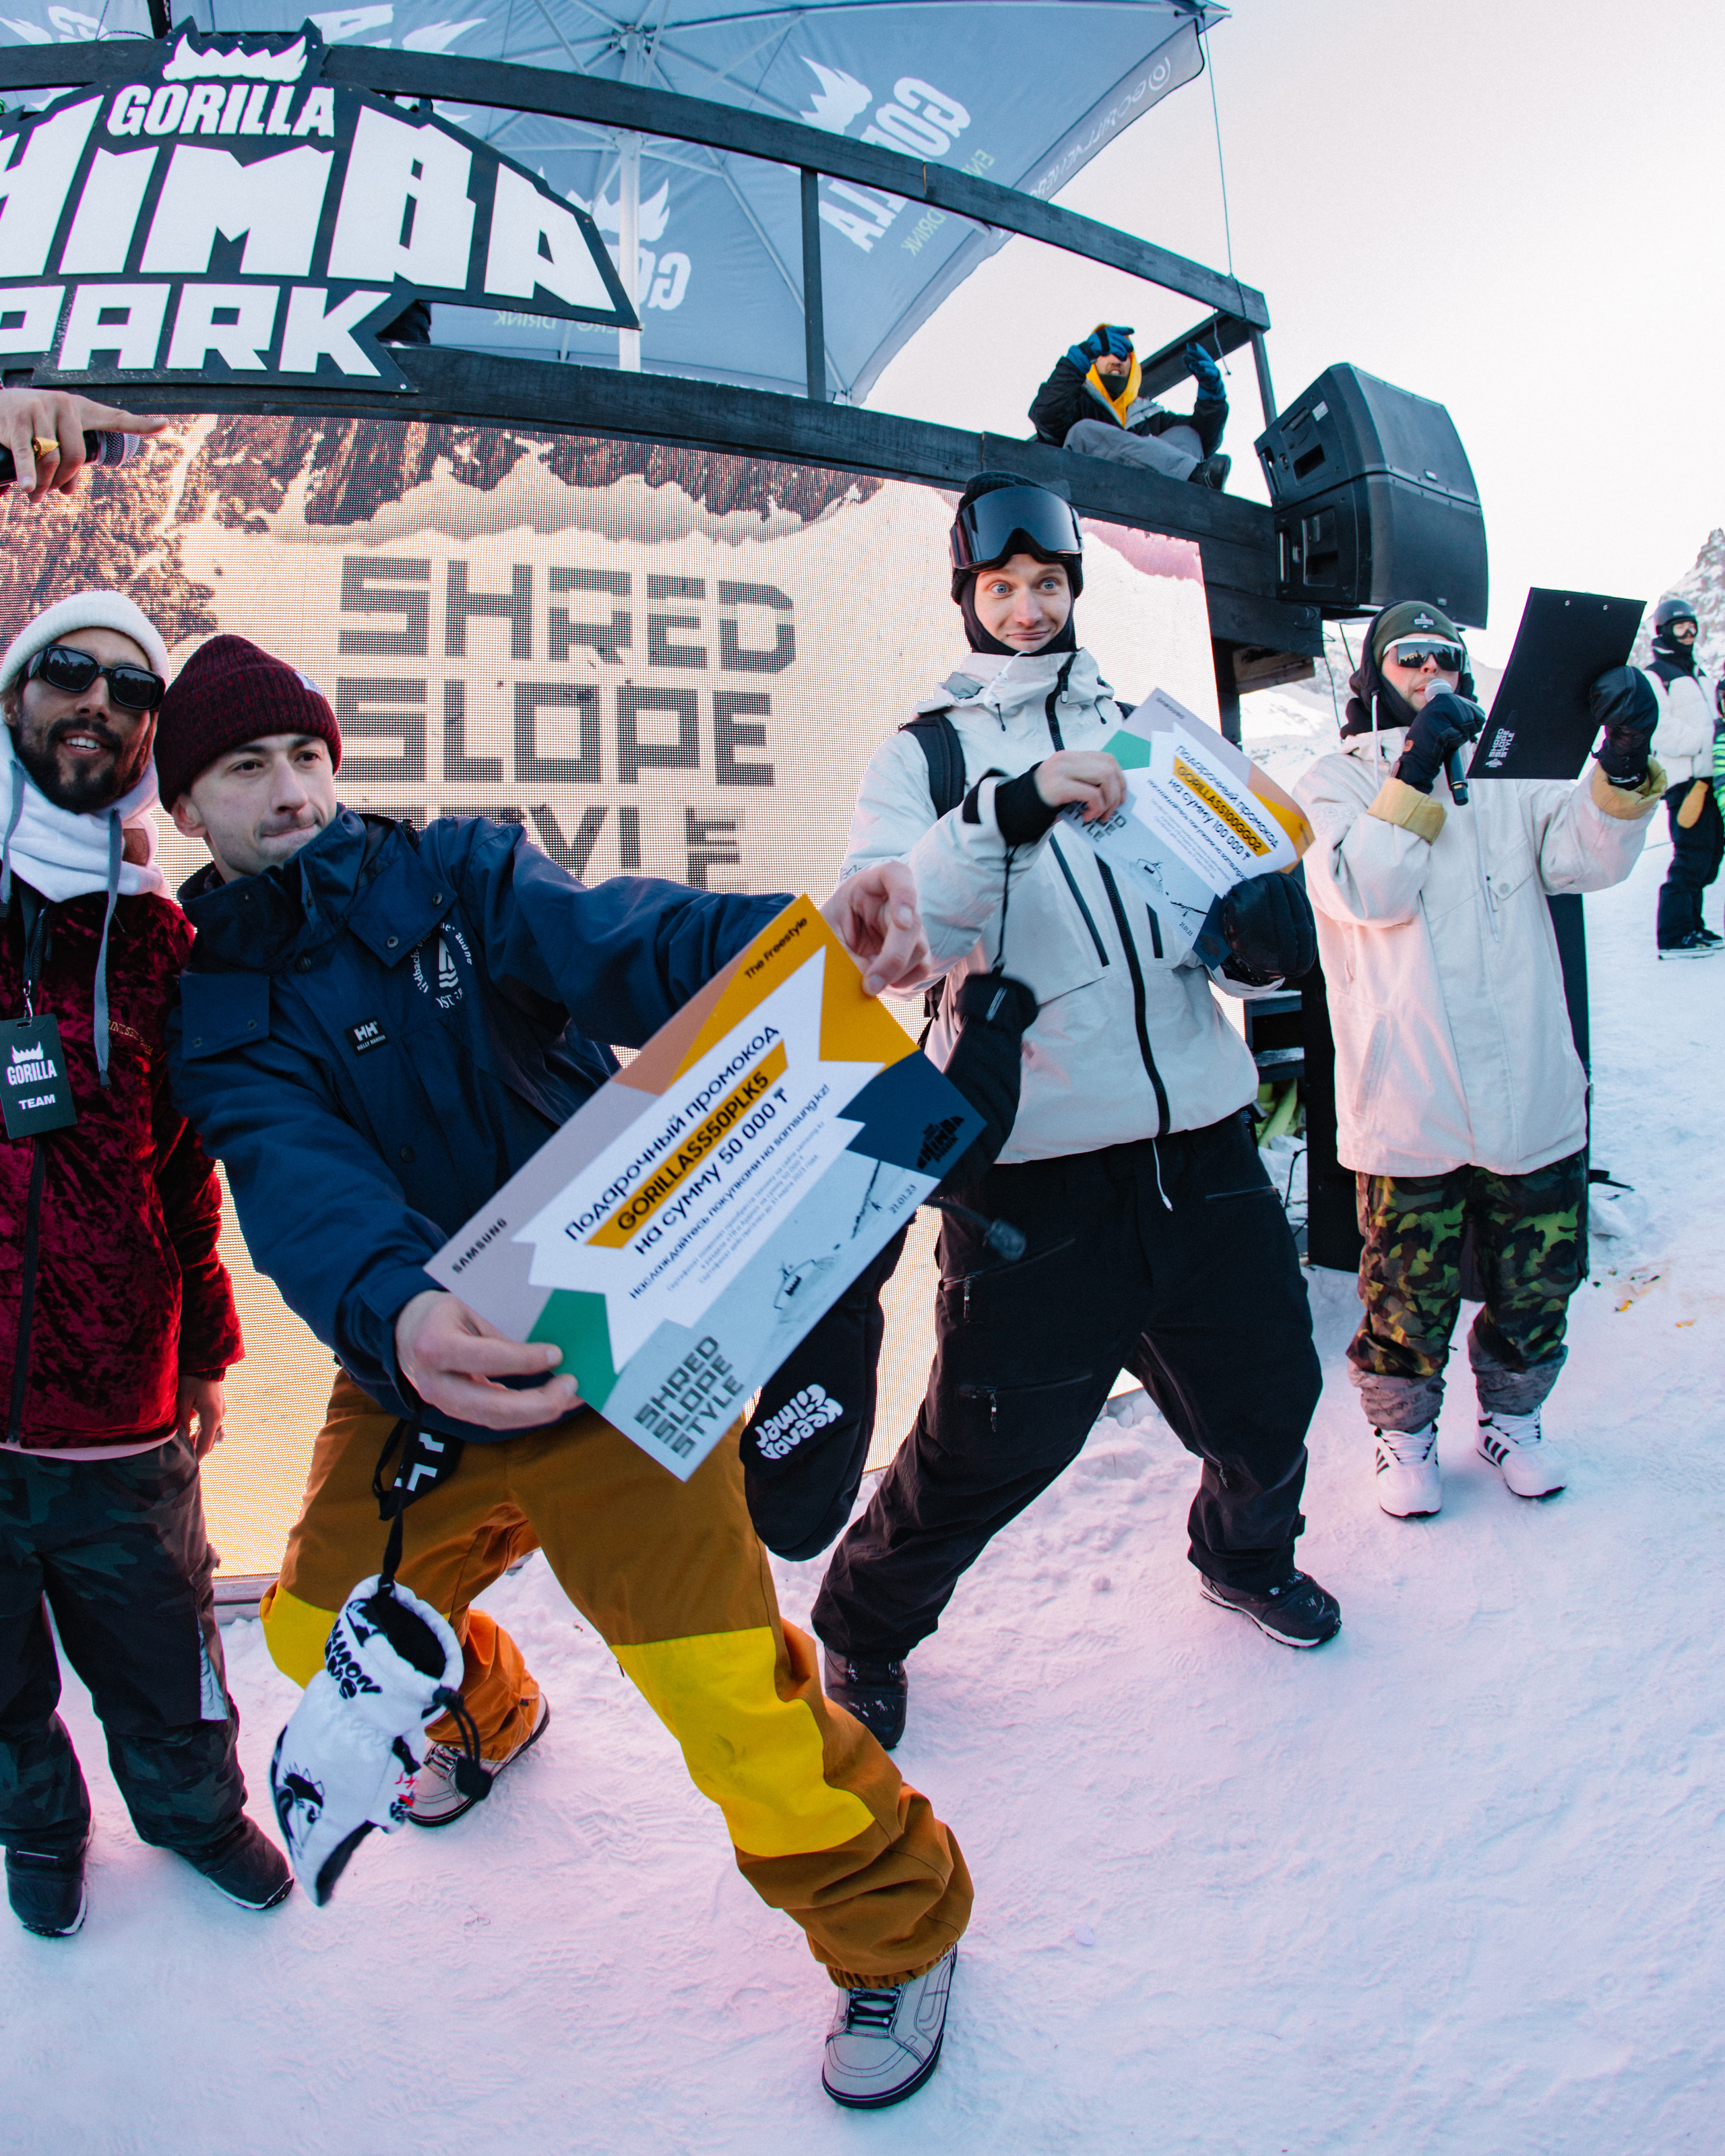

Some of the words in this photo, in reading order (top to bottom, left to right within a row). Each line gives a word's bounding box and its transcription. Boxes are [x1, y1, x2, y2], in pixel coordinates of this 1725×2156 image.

[106, 84, 335, 137] GORILLA
[0, 283, 391, 377] PARK
[338, 555, 796, 673] SHRED
[336, 677, 774, 786] SLOPE
[1488, 728, 1505, 758] SHRED
[1495, 730, 1510, 758] SLOPE
[1500, 732, 1515, 758] STYLE
[1168, 779, 1183, 793] на
[1183, 792, 1214, 823] сумму
[1212, 820, 1228, 837] 100
[1226, 835, 1244, 854] 000
[1236, 801, 1278, 849] промокод
[744, 959, 764, 979] The
[763, 918, 807, 962] Freestyle
[1179, 922, 1193, 936] 21.01.23
[6, 1059, 58, 1085] GORILLA
[18, 1093, 56, 1110] TEAM
[564, 1114, 686, 1240] Подарочный
[685, 1026, 779, 1118] промокод
[617, 1071, 768, 1230] GORILLASS50PLK5
[629, 1216, 710, 1299] Наслаждайтесь
[708, 1159, 761, 1216] покупками
[759, 1145, 775, 1161] на
[773, 1083, 829, 1146] samsung.kz!
[634, 1225, 662, 1255] на
[662, 1162, 721, 1226] сумму
[718, 1137, 743, 1164] 50
[741, 1102, 776, 1139] 000
[889, 1184, 916, 1214] 21.01.23
[451, 1217, 507, 1273] SAMSUNG
[633, 1335, 718, 1430] SHRED
[652, 1354, 732, 1444] SLOPE
[666, 1374, 745, 1459] STYLE
